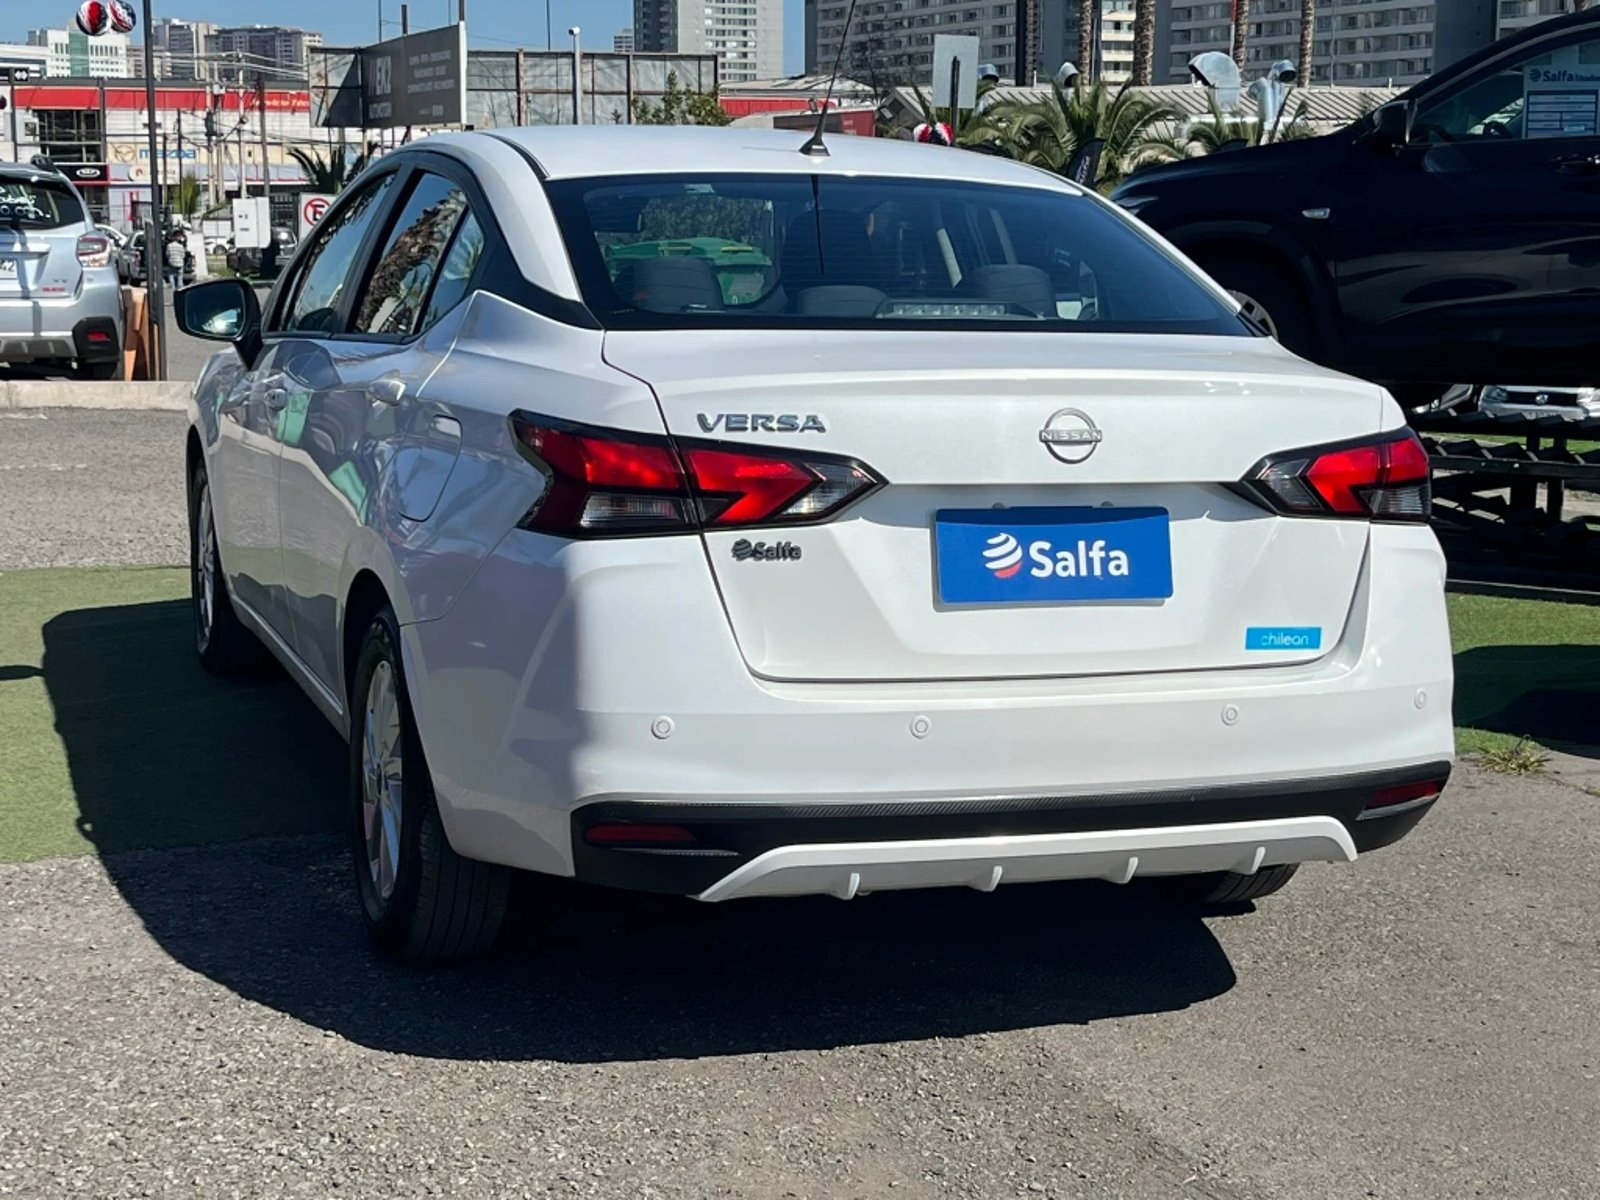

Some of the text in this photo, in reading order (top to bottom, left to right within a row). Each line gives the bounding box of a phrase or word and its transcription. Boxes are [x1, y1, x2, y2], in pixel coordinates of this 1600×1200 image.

[1543, 70, 1574, 82] Salfa
[696, 413, 827, 433] VERSA
[1040, 431, 1102, 441] NISSAN
[753, 541, 802, 561] Salfa
[1029, 540, 1129, 578] Salfa
[1261, 632, 1309, 647] chilean
